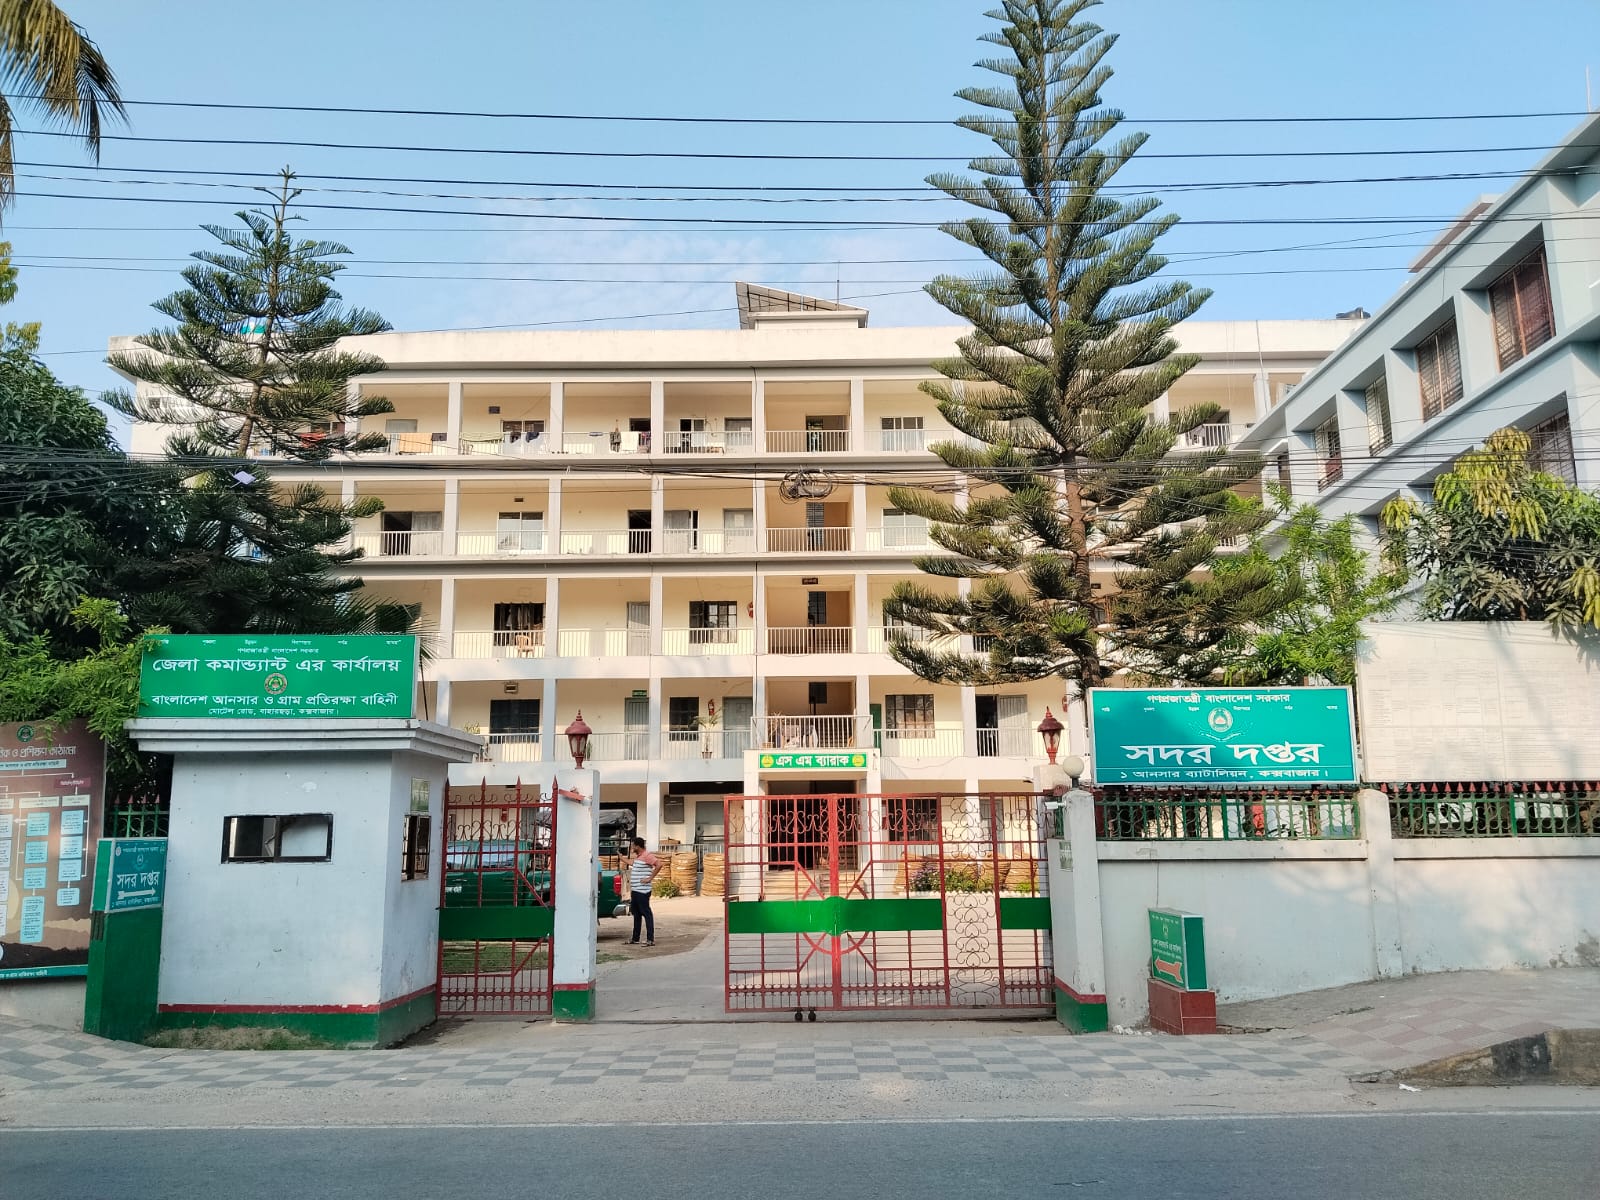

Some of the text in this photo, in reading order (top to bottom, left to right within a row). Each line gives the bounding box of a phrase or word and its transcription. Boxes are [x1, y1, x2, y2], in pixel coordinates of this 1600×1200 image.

[152, 658, 201, 672] জেলা
[296, 658, 327, 672] এর
[331, 656, 402, 672] কার্যালয়
[152, 692, 399, 706] বাংলাদেশ আনসার ও গ্রাম প্রতিরক্ষা বাহিনী
[1204, 694, 1253, 704] বাংলাদেশ
[1255, 694, 1291, 703] সরকার
[1119, 740, 1325, 766] সদর দপ্তর
[775, 755, 850, 767] এস এম ব্যারাক
[1120, 770, 1128, 779] ১
[1132, 771, 1180, 779] আনসার
[116, 870, 161, 889] সদর দপ্তর
